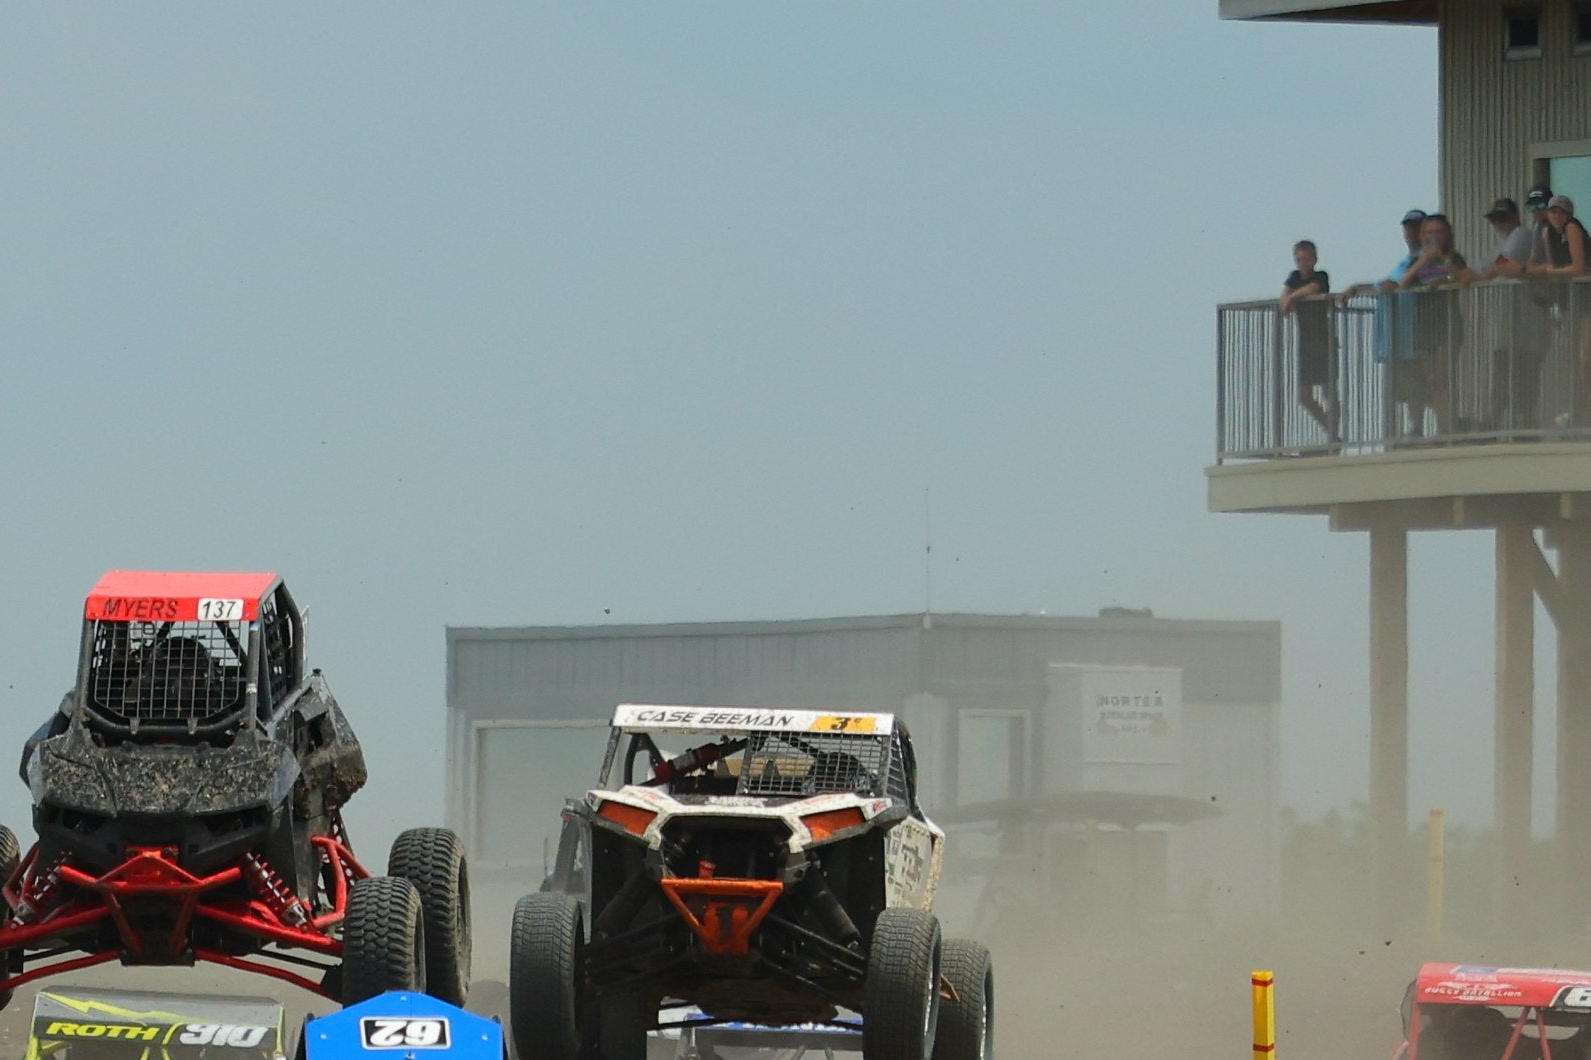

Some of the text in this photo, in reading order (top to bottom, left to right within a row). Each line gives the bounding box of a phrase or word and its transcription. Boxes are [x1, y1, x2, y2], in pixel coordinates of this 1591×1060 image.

[102, 598, 237, 619] MYERS 137
[637, 710, 693, 724] CASE
[699, 713, 795, 727] BEEMAN
[46, 1021, 269, 1048] ROTH 910
